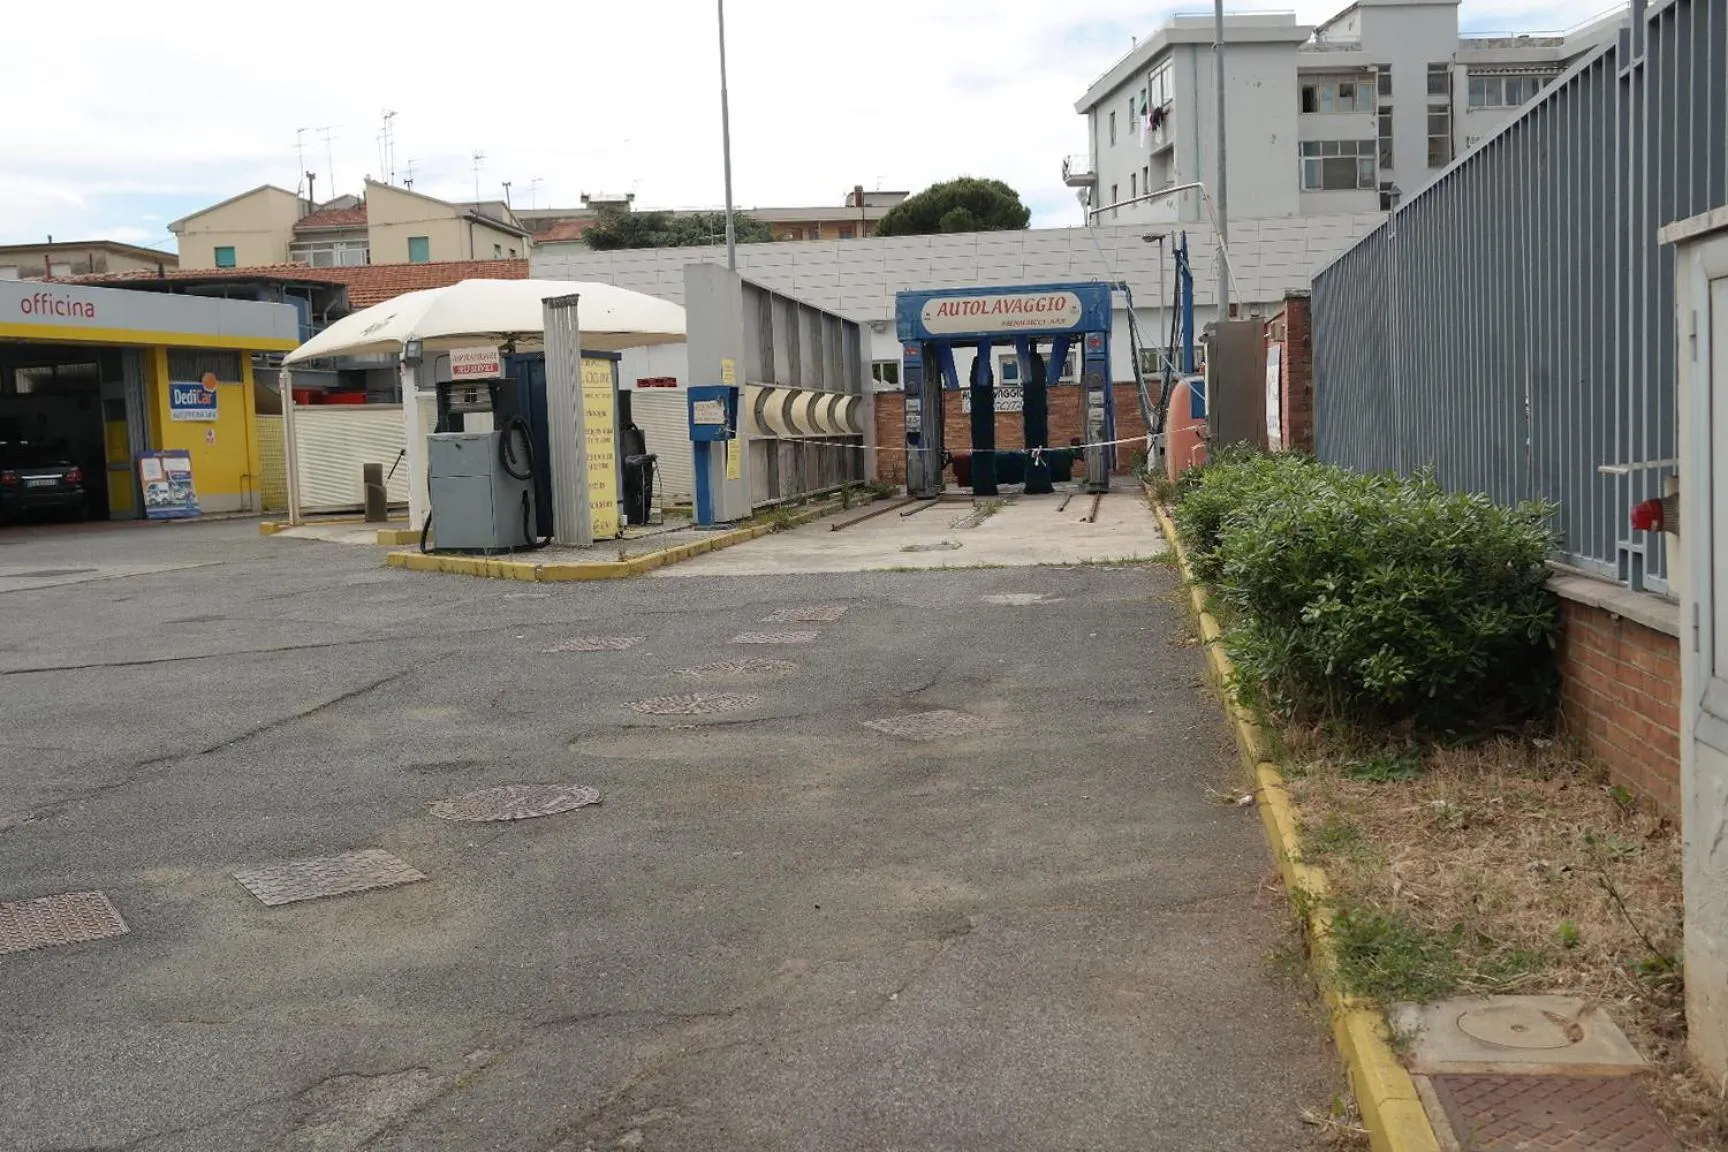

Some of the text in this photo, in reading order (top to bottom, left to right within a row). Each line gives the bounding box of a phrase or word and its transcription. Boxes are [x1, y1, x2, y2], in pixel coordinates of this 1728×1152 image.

[21, 292, 95, 318] officina
[937, 296, 1067, 317] AUTOLAVAGGIO
[174, 388, 212, 405] DediCar
